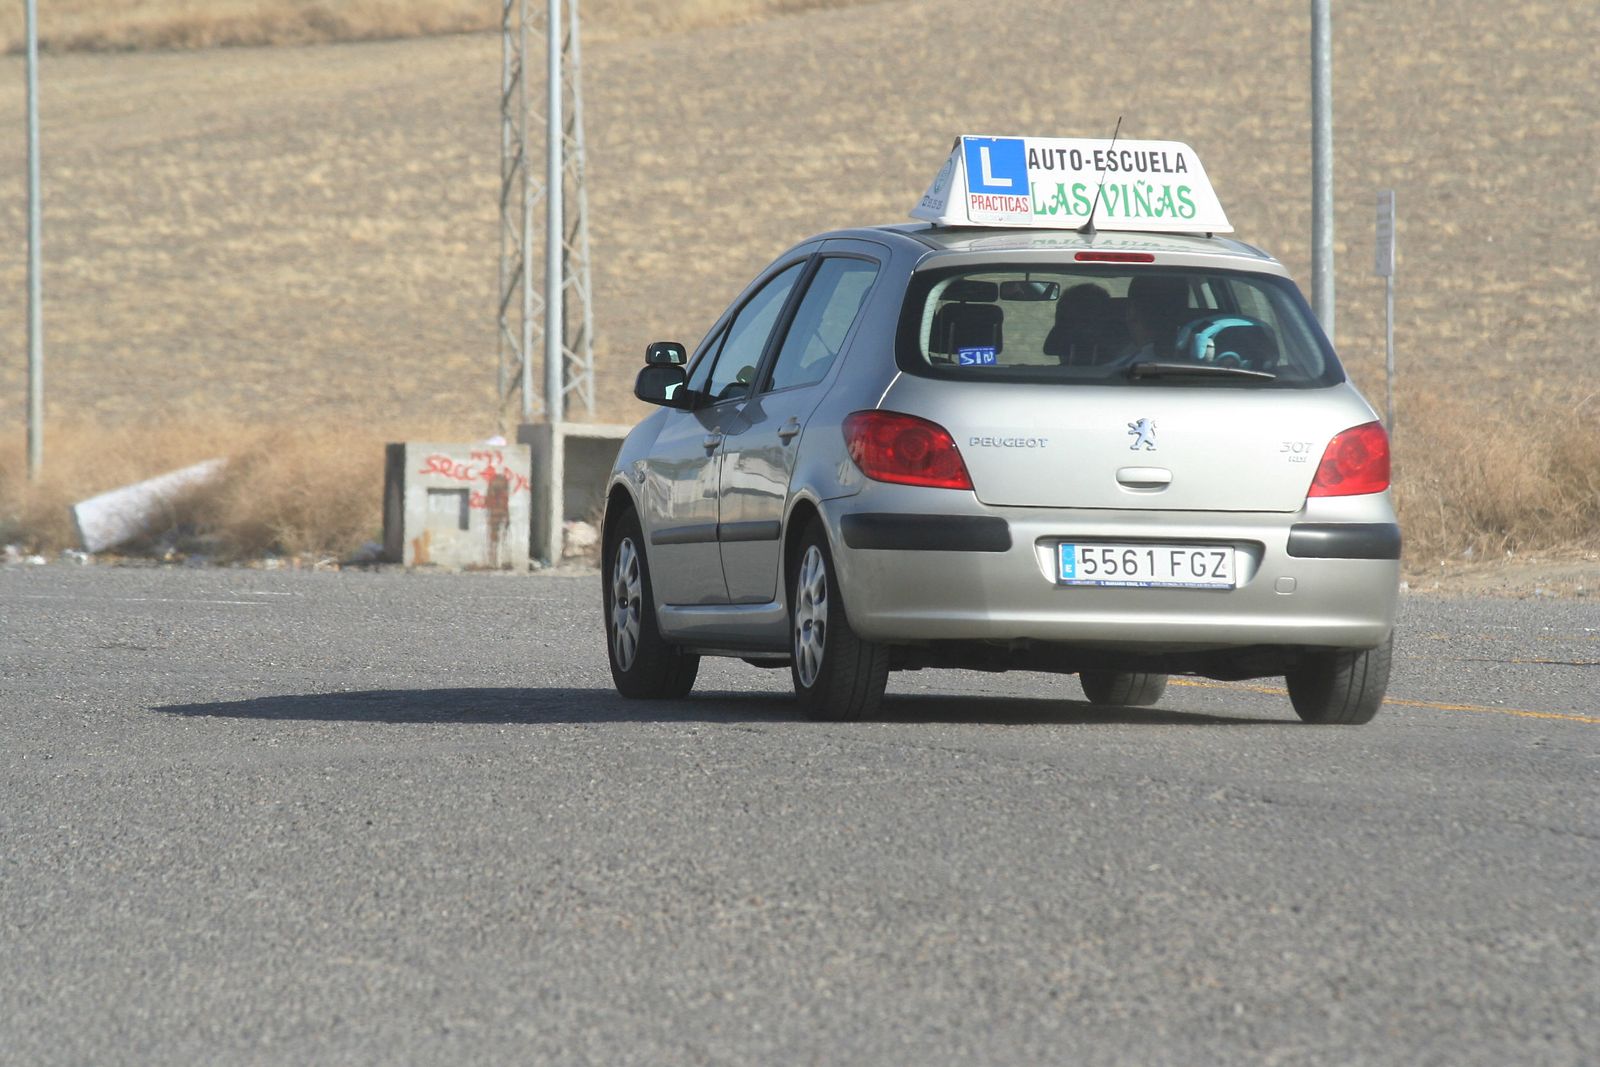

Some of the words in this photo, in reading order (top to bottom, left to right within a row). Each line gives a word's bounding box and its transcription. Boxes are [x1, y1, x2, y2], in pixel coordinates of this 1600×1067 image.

[979, 146, 1013, 187] L
[1028, 148, 1188, 174] AUTO-ESCUELA
[970, 194, 1030, 213] PRACTICAS
[1031, 180, 1092, 217] LAS
[1098, 179, 1197, 219] VIÑAS
[969, 437, 1049, 448] PEUGEOT
[1279, 441, 1313, 454] 307
[1081, 548, 1155, 576] 5561
[1170, 550, 1228, 578] FGZ
